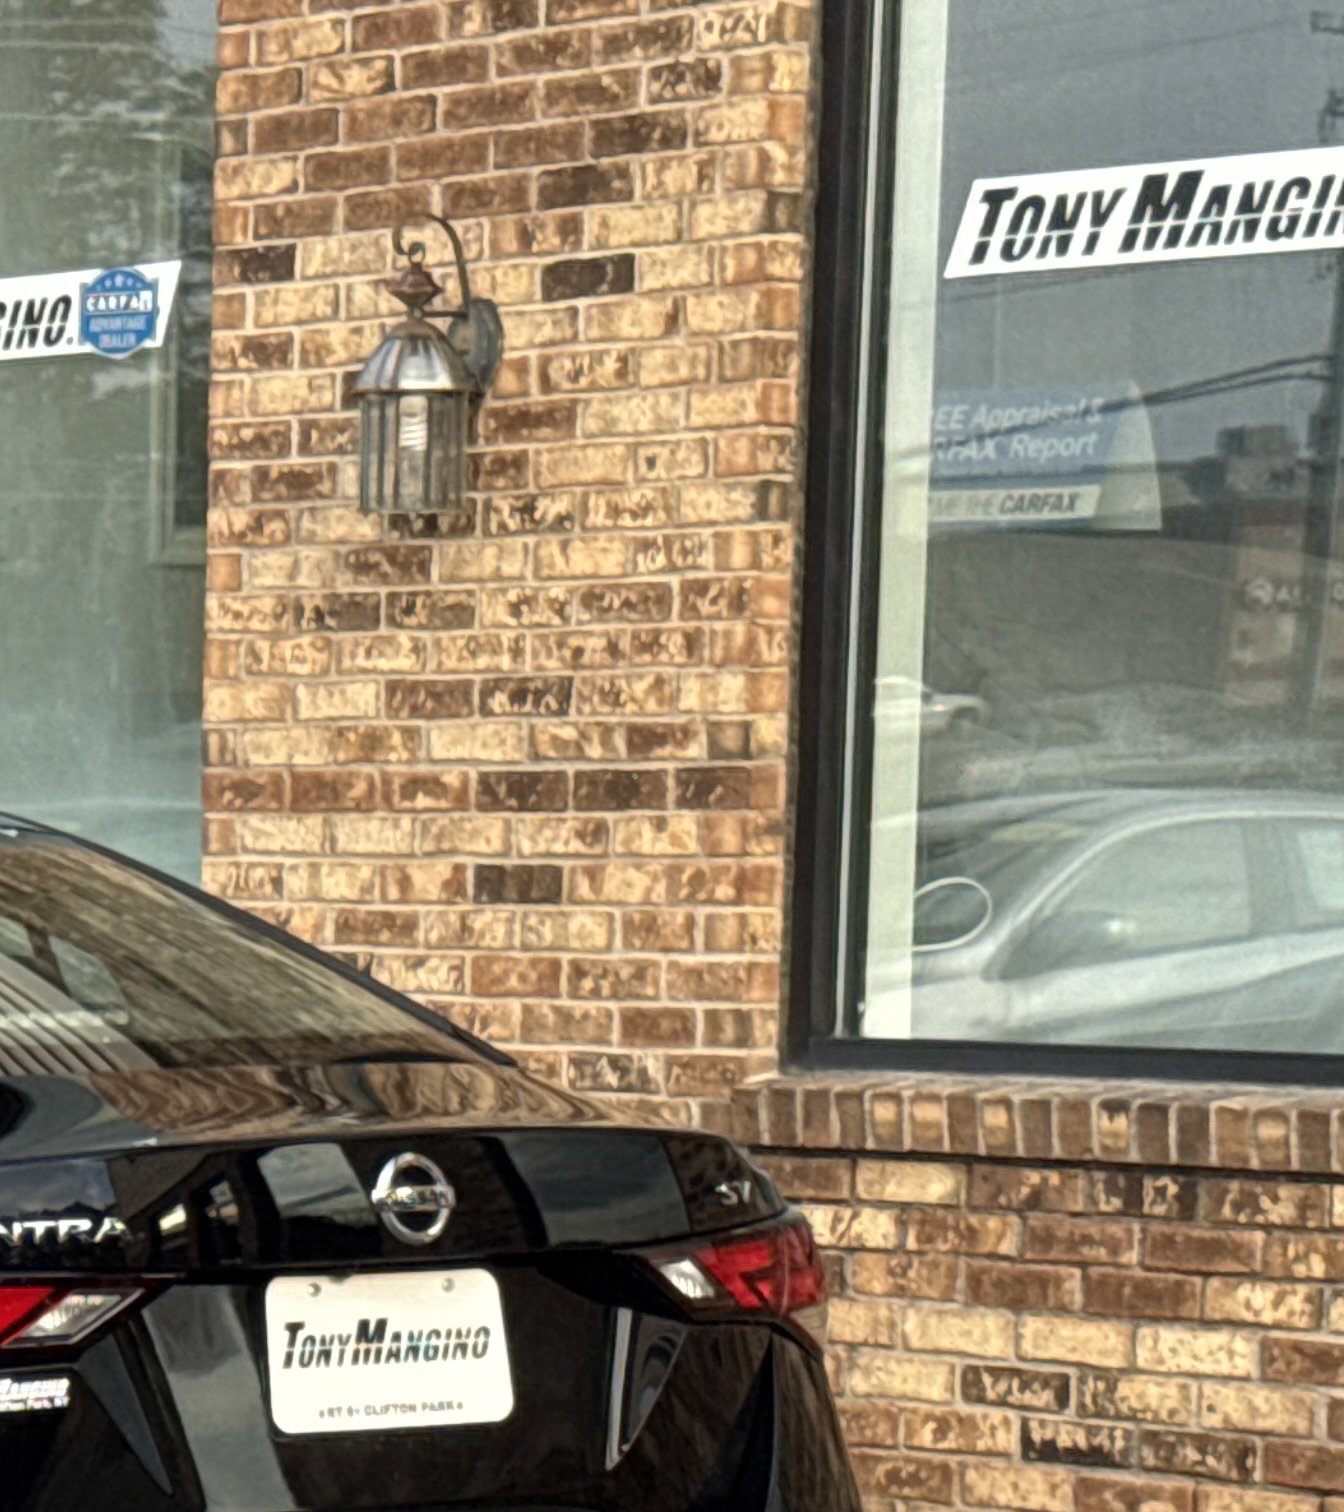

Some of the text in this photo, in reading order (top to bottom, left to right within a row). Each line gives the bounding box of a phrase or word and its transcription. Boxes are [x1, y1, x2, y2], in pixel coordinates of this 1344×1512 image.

[1009, 432, 1099, 464] Report
[999, 492, 1081, 515] CARFAX
[364, 1403, 417, 1417] CLIFTON
[421, 1400, 454, 1412] PARK
